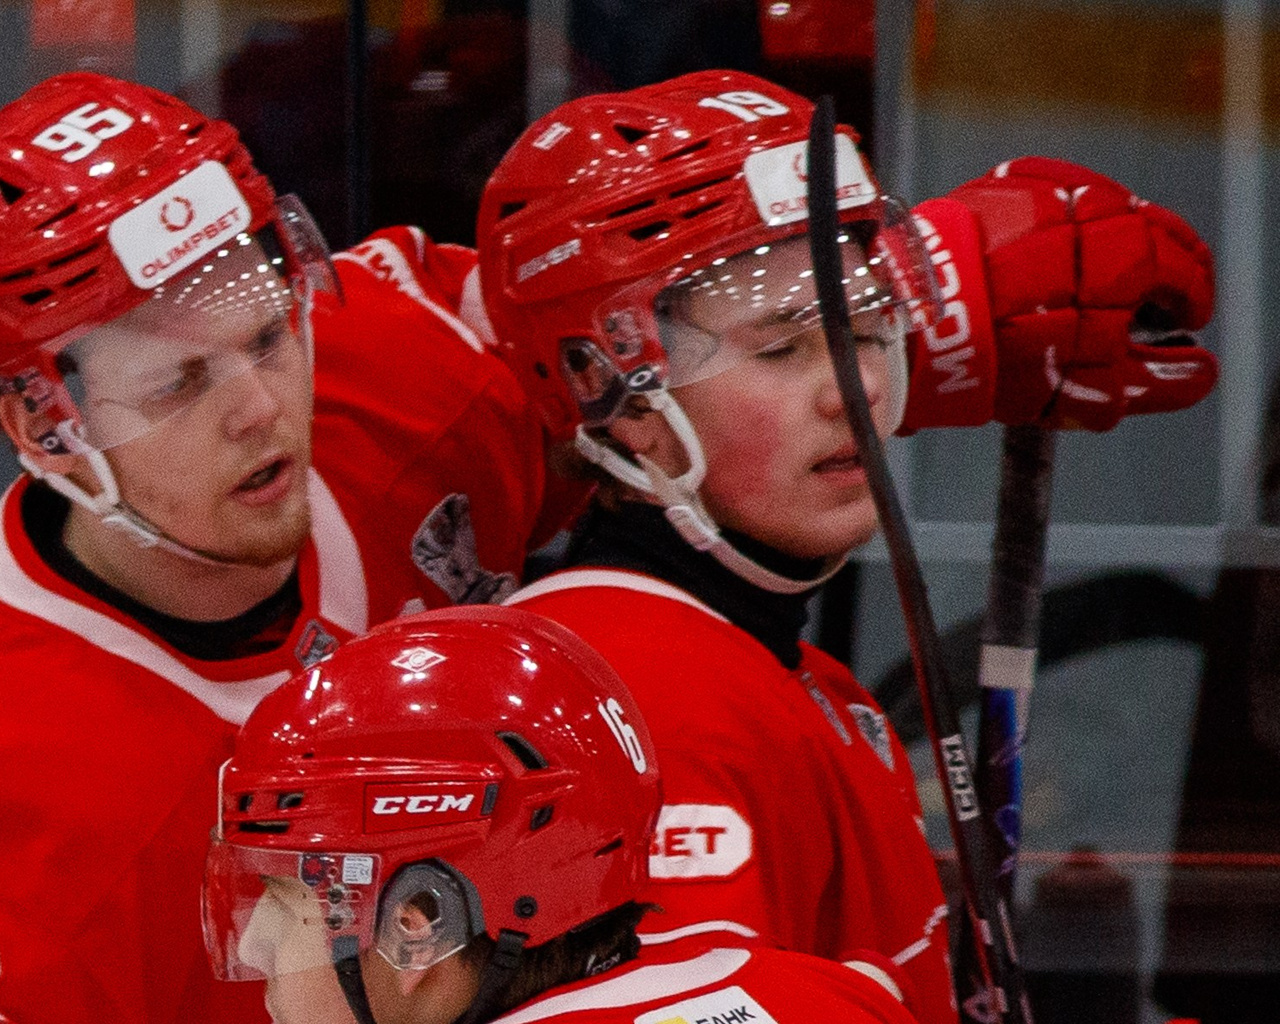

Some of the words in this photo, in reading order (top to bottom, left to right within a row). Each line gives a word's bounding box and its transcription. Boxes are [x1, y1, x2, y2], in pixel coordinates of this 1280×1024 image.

[31, 101, 135, 163] 95
[698, 89, 791, 122] 19
[140, 206, 240, 279] OLIMPBET
[597, 697, 648, 775] 16
[372, 793, 476, 816] CCM
